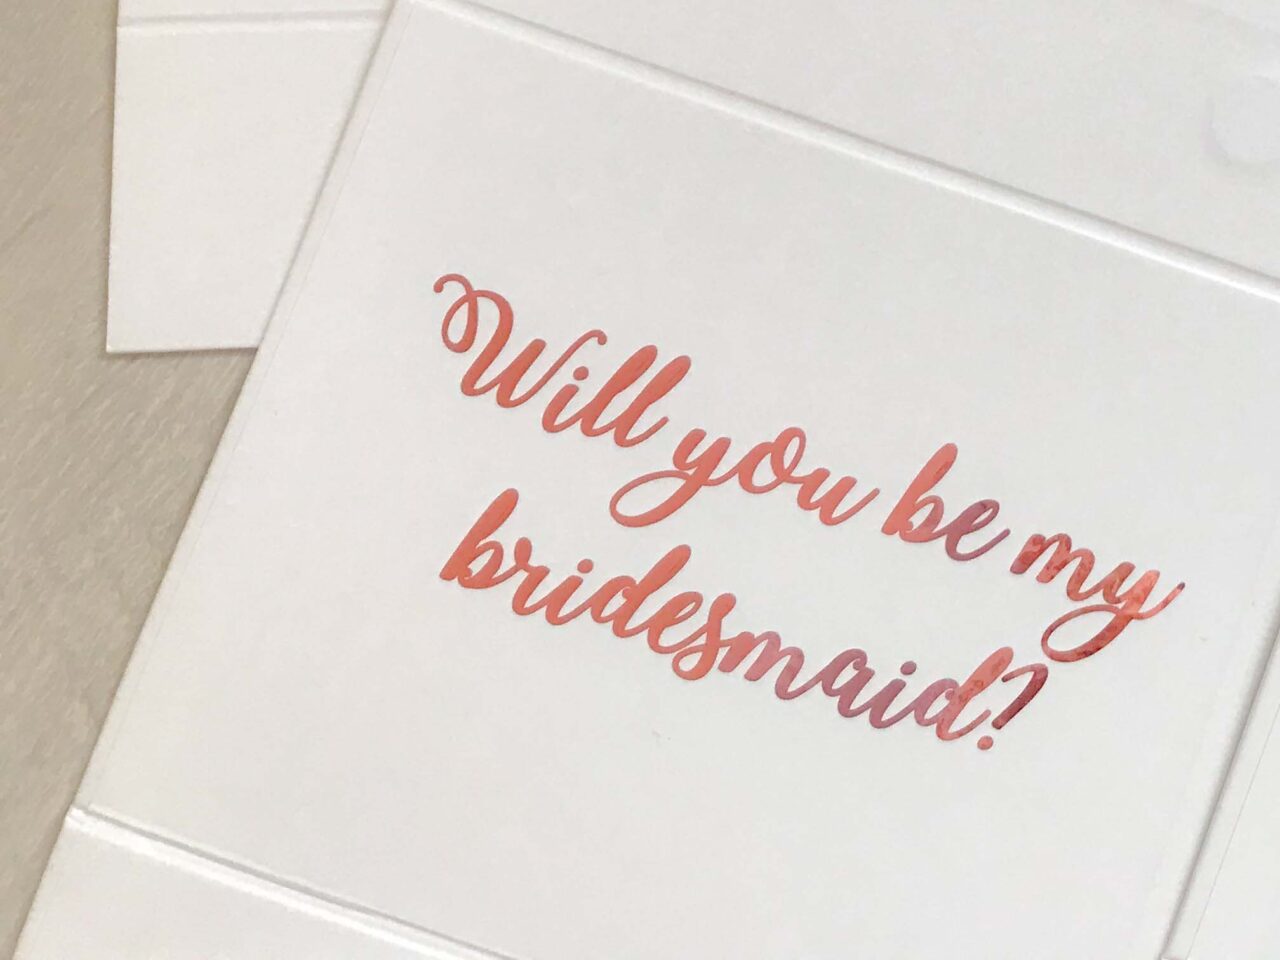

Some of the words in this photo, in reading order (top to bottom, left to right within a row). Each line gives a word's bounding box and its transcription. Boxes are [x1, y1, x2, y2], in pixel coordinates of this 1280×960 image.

[433, 273, 692, 448] Will
[609, 427, 879, 528] you
[881, 443, 1009, 562] be
[1009, 533, 1184, 663] my
[439, 488, 1049, 751] bridesmaid?
